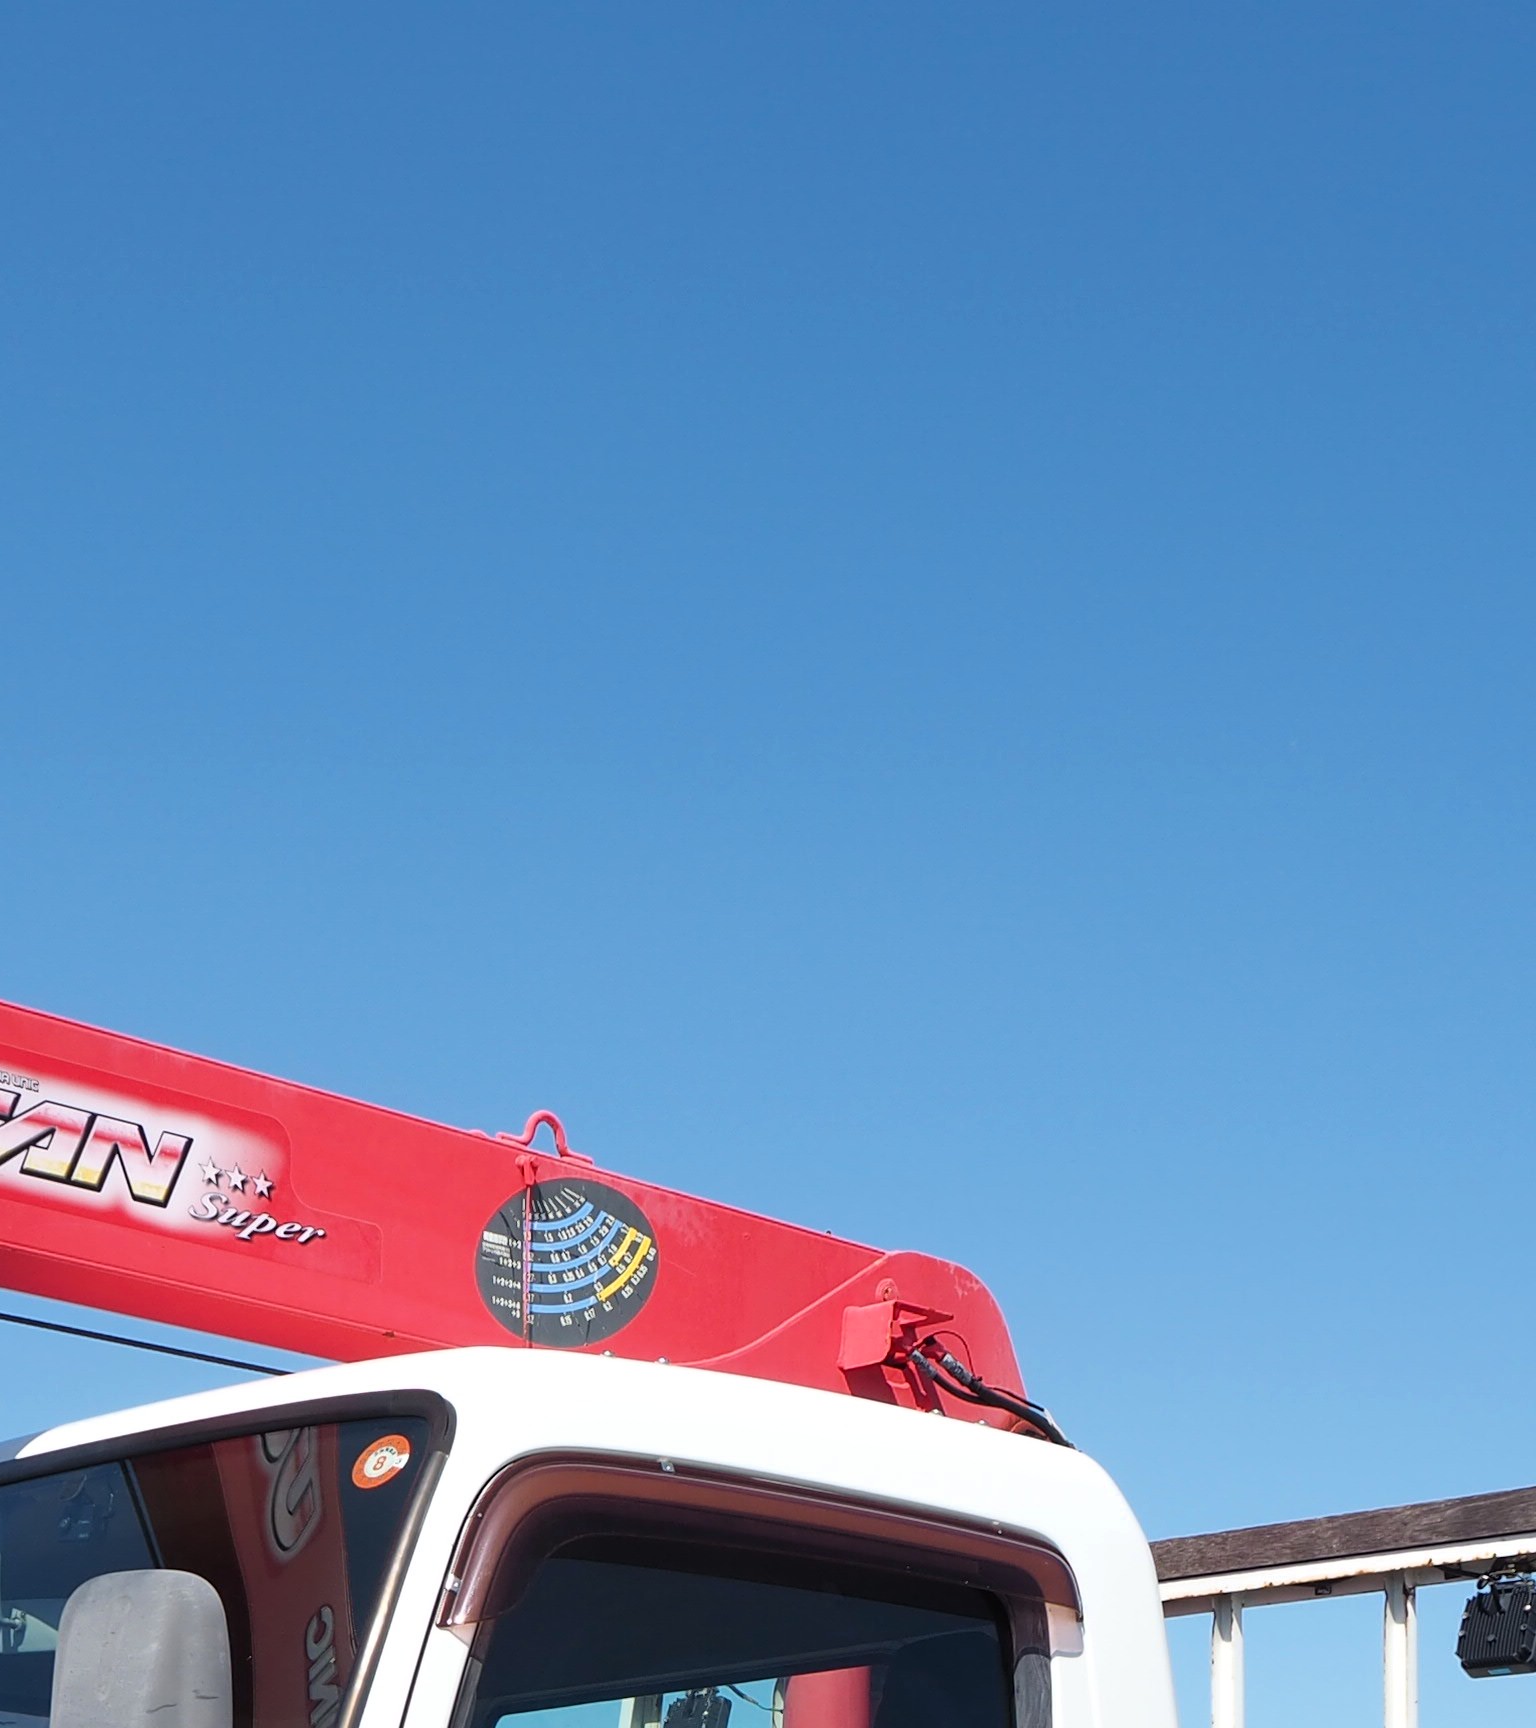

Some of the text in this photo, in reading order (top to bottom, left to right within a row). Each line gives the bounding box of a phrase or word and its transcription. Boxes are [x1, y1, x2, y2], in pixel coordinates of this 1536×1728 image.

[11, 1074, 39, 1092] UNIC
[189, 1192, 327, 1247] Super
[372, 1456, 387, 1471] 8
